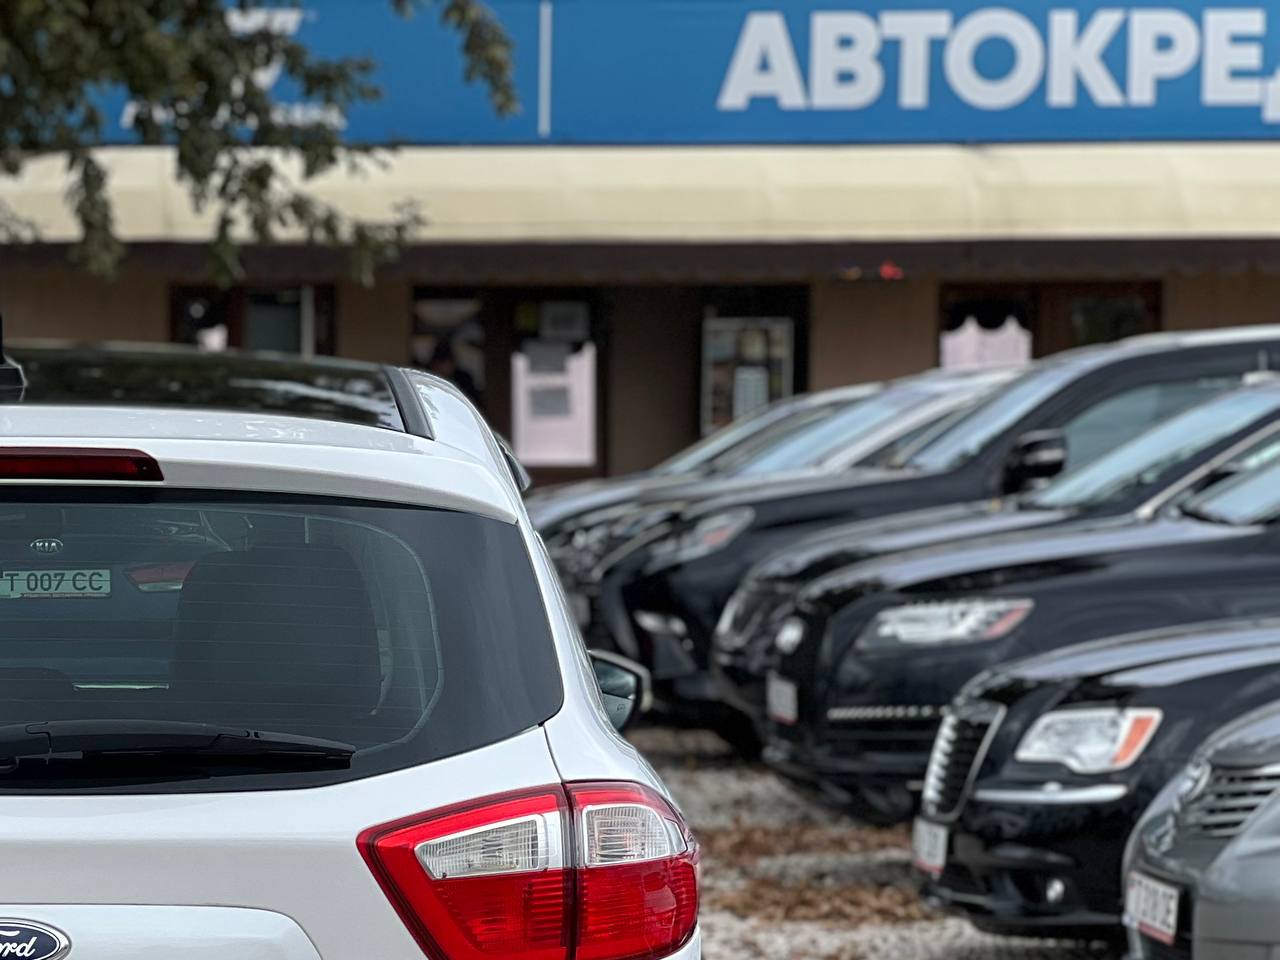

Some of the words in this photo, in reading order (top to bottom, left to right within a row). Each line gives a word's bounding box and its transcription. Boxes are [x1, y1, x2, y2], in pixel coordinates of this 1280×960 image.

[718, 7, 1280, 122] АВТОКРЕ
[34, 541, 58, 552] KIA
[4, 572, 20, 592] T
[26, 572, 66, 591] 007
[72, 571, 103, 591] CC
